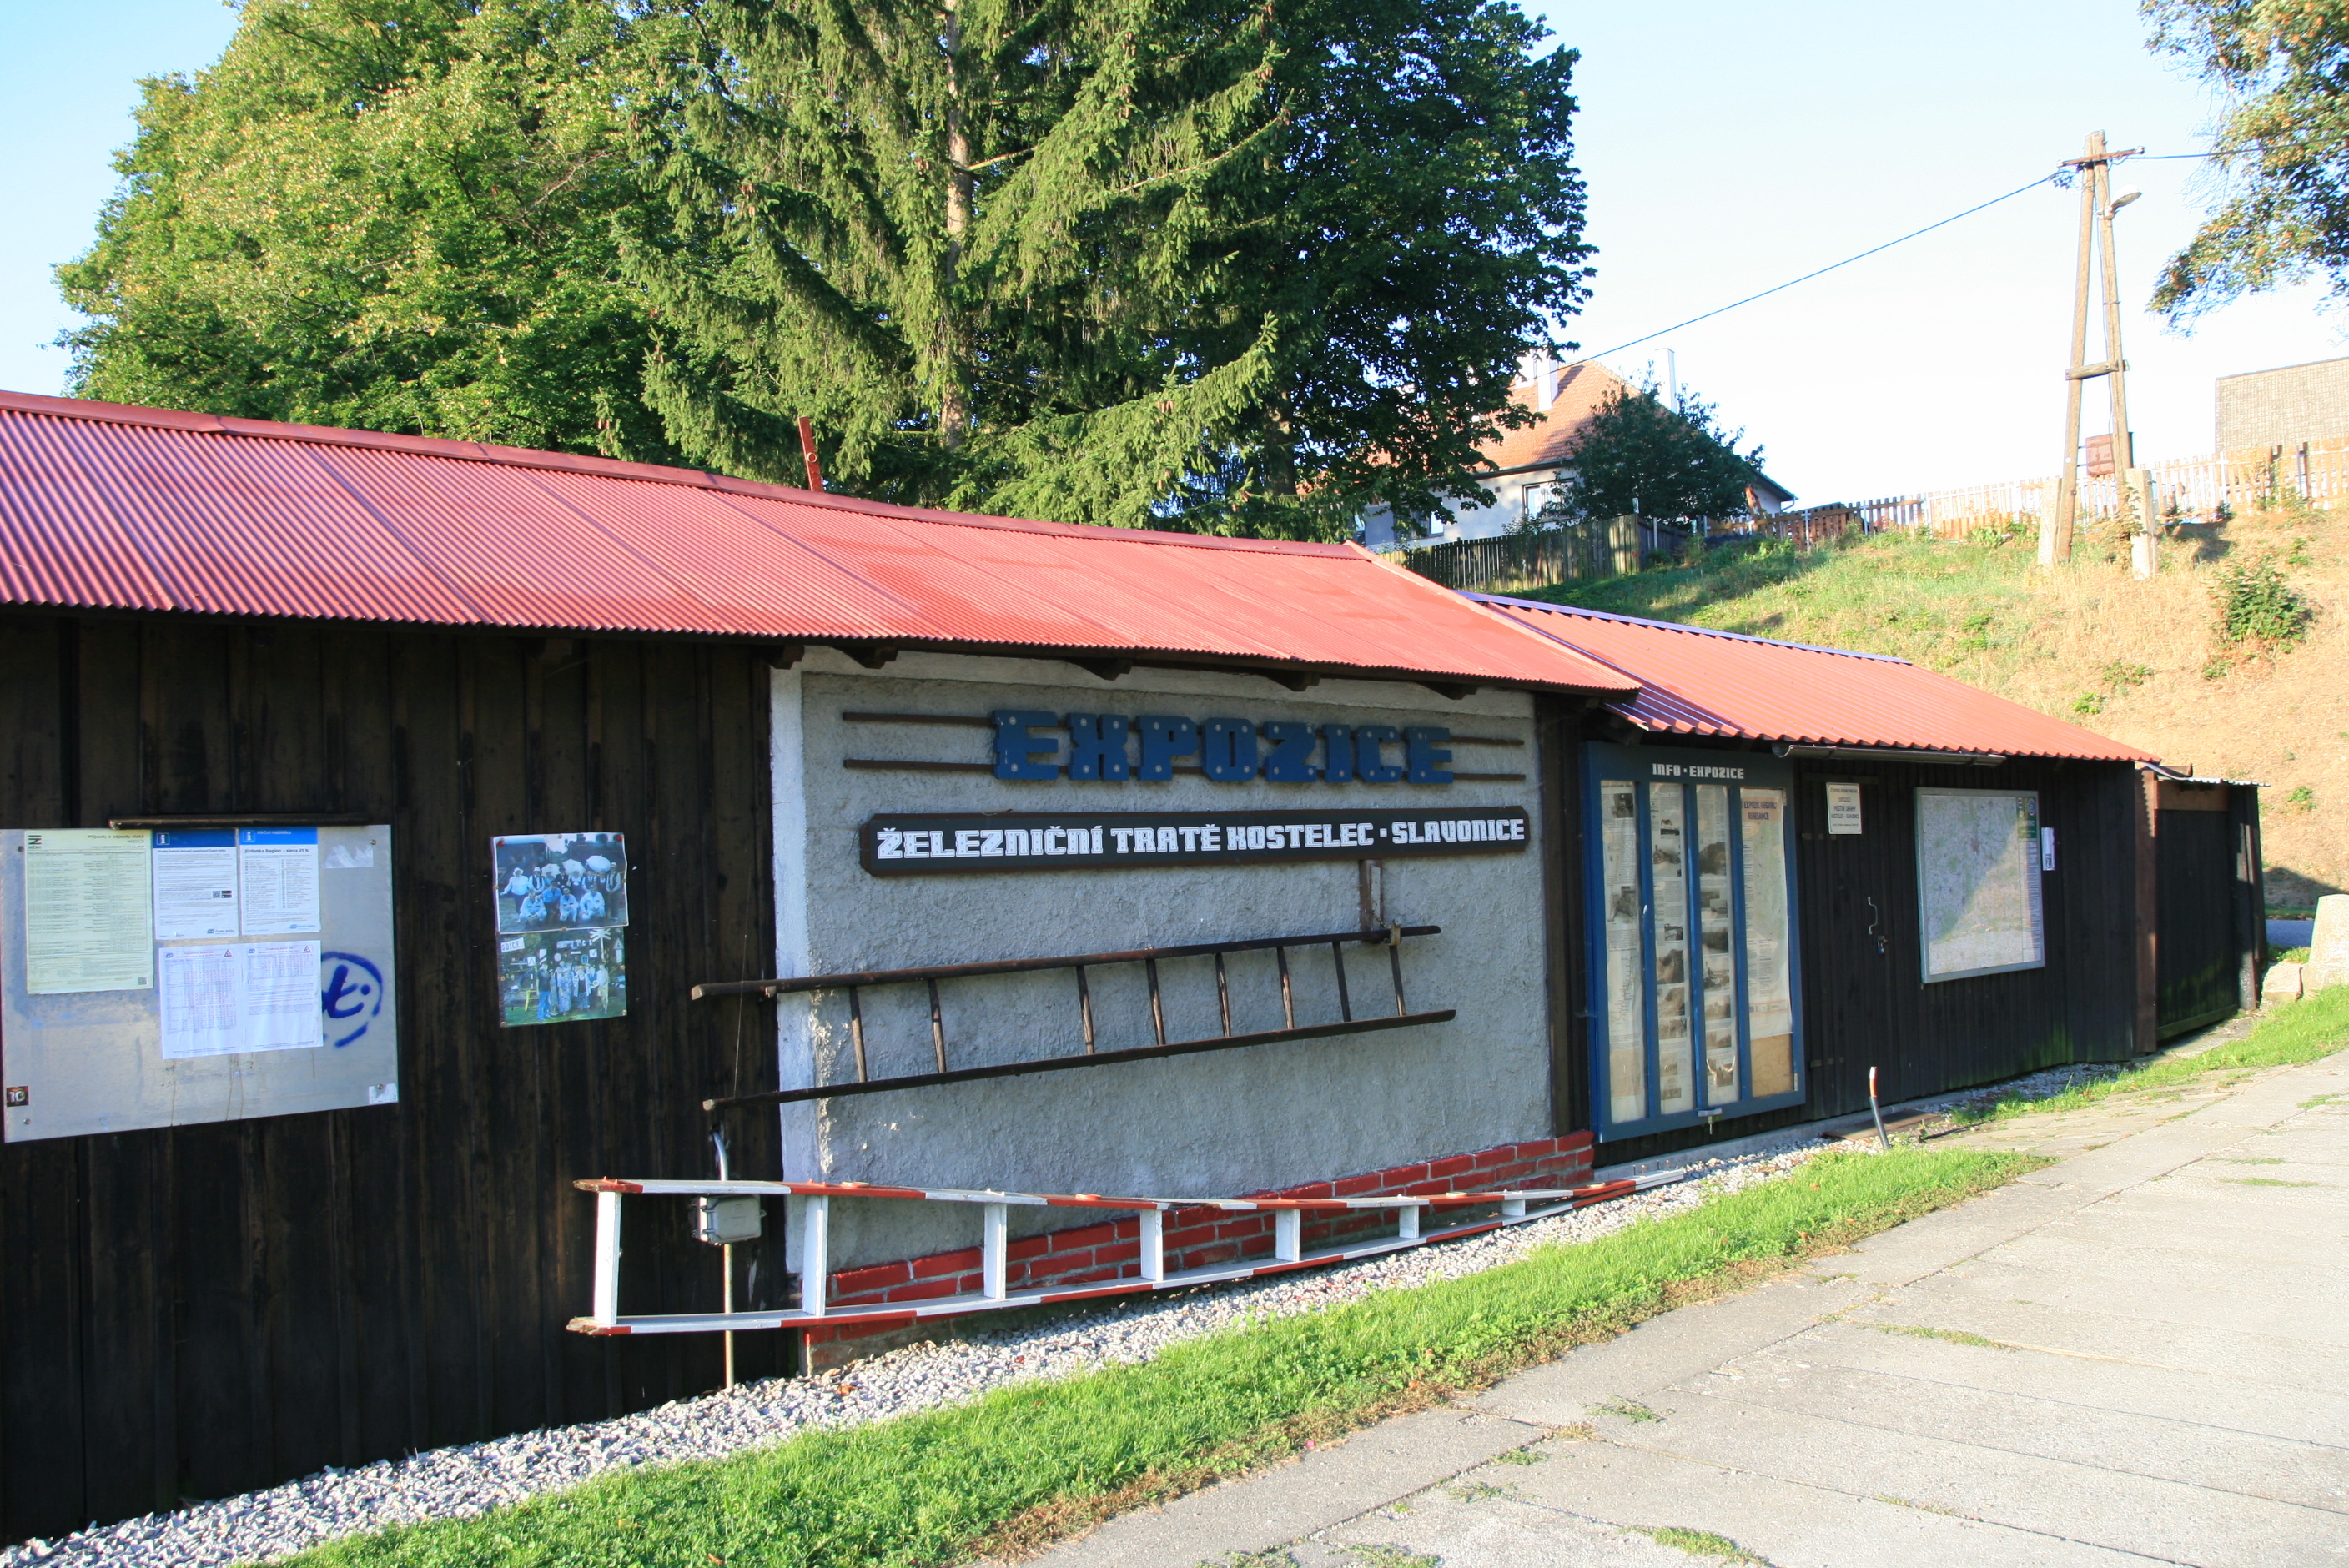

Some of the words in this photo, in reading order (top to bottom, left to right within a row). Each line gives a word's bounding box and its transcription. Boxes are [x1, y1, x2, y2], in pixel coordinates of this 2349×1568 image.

[992, 709, 1454, 783] EXPOZICE
[1652, 763, 1681, 776] INFO
[1689, 766, 1744, 779] EXPOZICE
[877, 826, 1104, 859] ŽELEZNIČNÍ
[1111, 823, 1221, 852] TRATĚ
[1226, 823, 1374, 851] KOSTELEC
[1391, 818, 1526, 845] SLAVONICE
